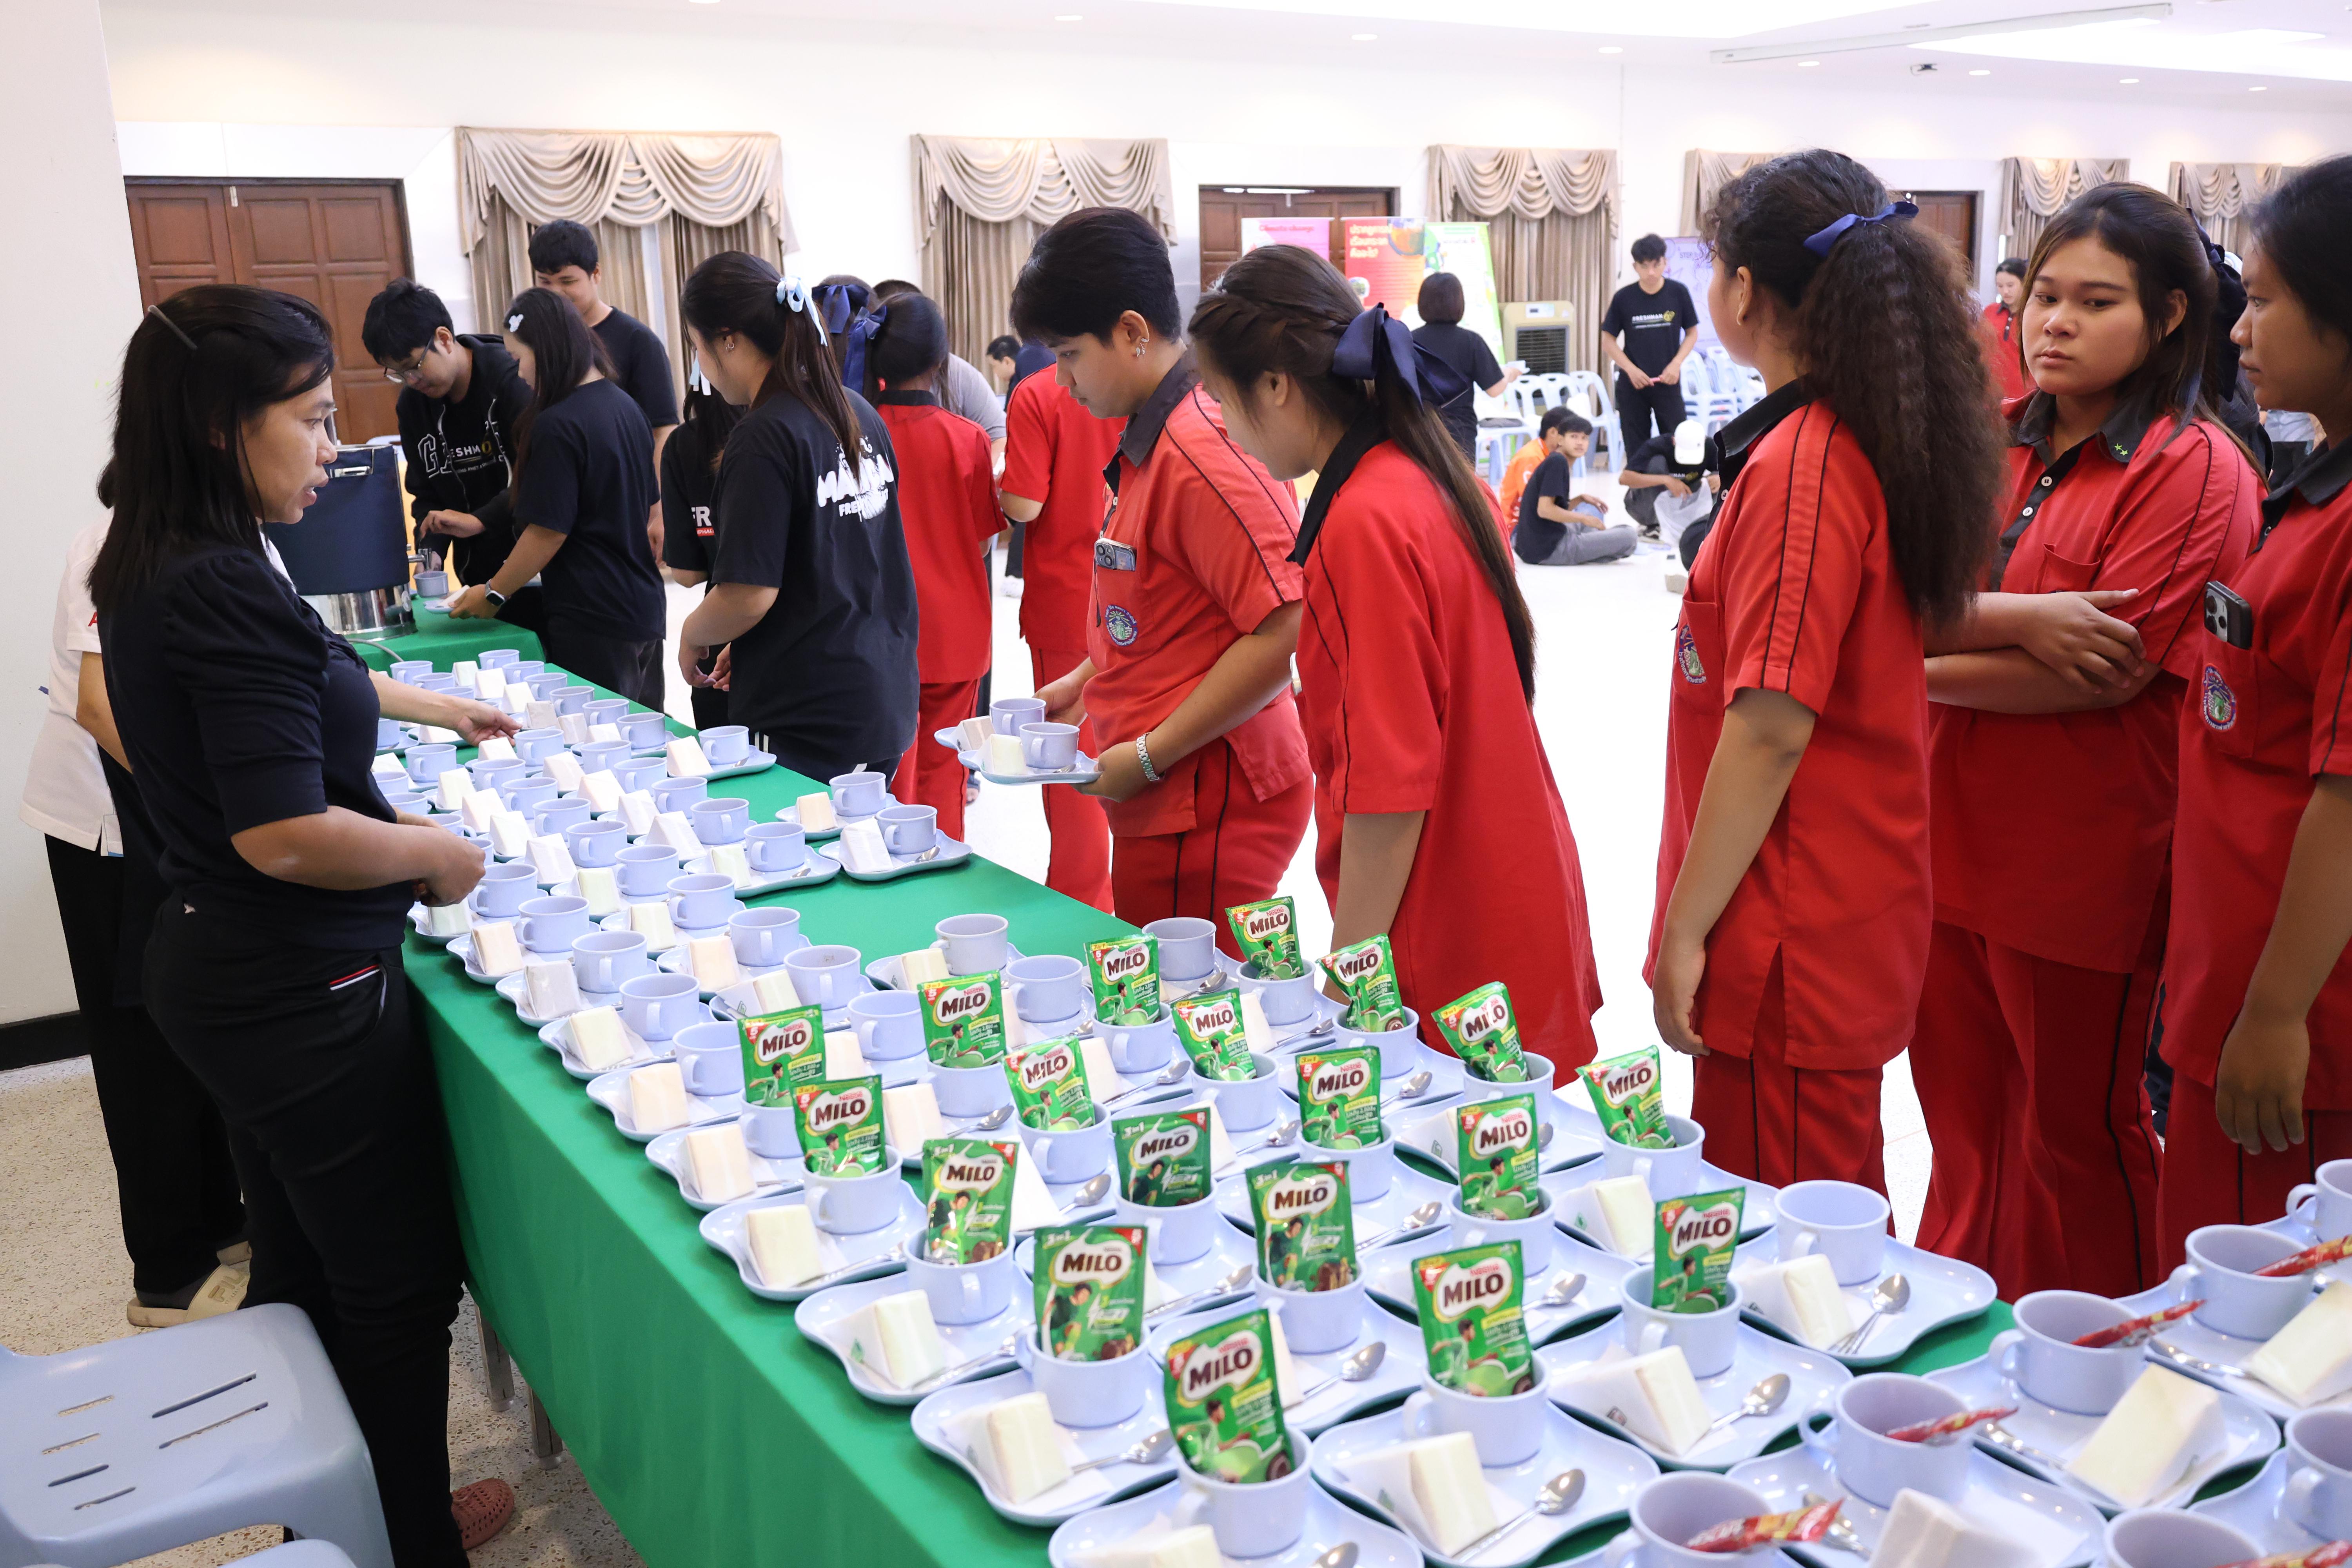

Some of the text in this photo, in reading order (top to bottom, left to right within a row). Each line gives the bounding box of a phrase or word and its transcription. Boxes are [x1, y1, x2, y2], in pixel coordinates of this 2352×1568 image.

[1250, 913, 1288, 935] MILO
[1107, 952, 1145, 976] MILO
[1339, 953, 1378, 978] MILO
[942, 993, 986, 1017] MILO
[1196, 1009, 1233, 1032] MILO
[1466, 1005, 1505, 1037] MIO
[763, 1030, 806, 1056] MILO
[1026, 1055, 1067, 1083] MILO
[1318, 1070, 1363, 1094] MILO
[1607, 1068, 1651, 1098] MILO
[815, 1099, 866, 1125] MILO
[1141, 1134, 1189, 1158] MILO
[1480, 1121, 1527, 1149] MILO
[947, 1165, 995, 1181] MILO
[1275, 1187, 1328, 1210] MILO
[1677, 1218, 1731, 1247] MILO
[1063, 1254, 1122, 1272] MILO
[208, 1268, 249, 1302] FIL
[1444, 1274, 1503, 1308] MILO
[1189, 1348, 1253, 1391] MILO
